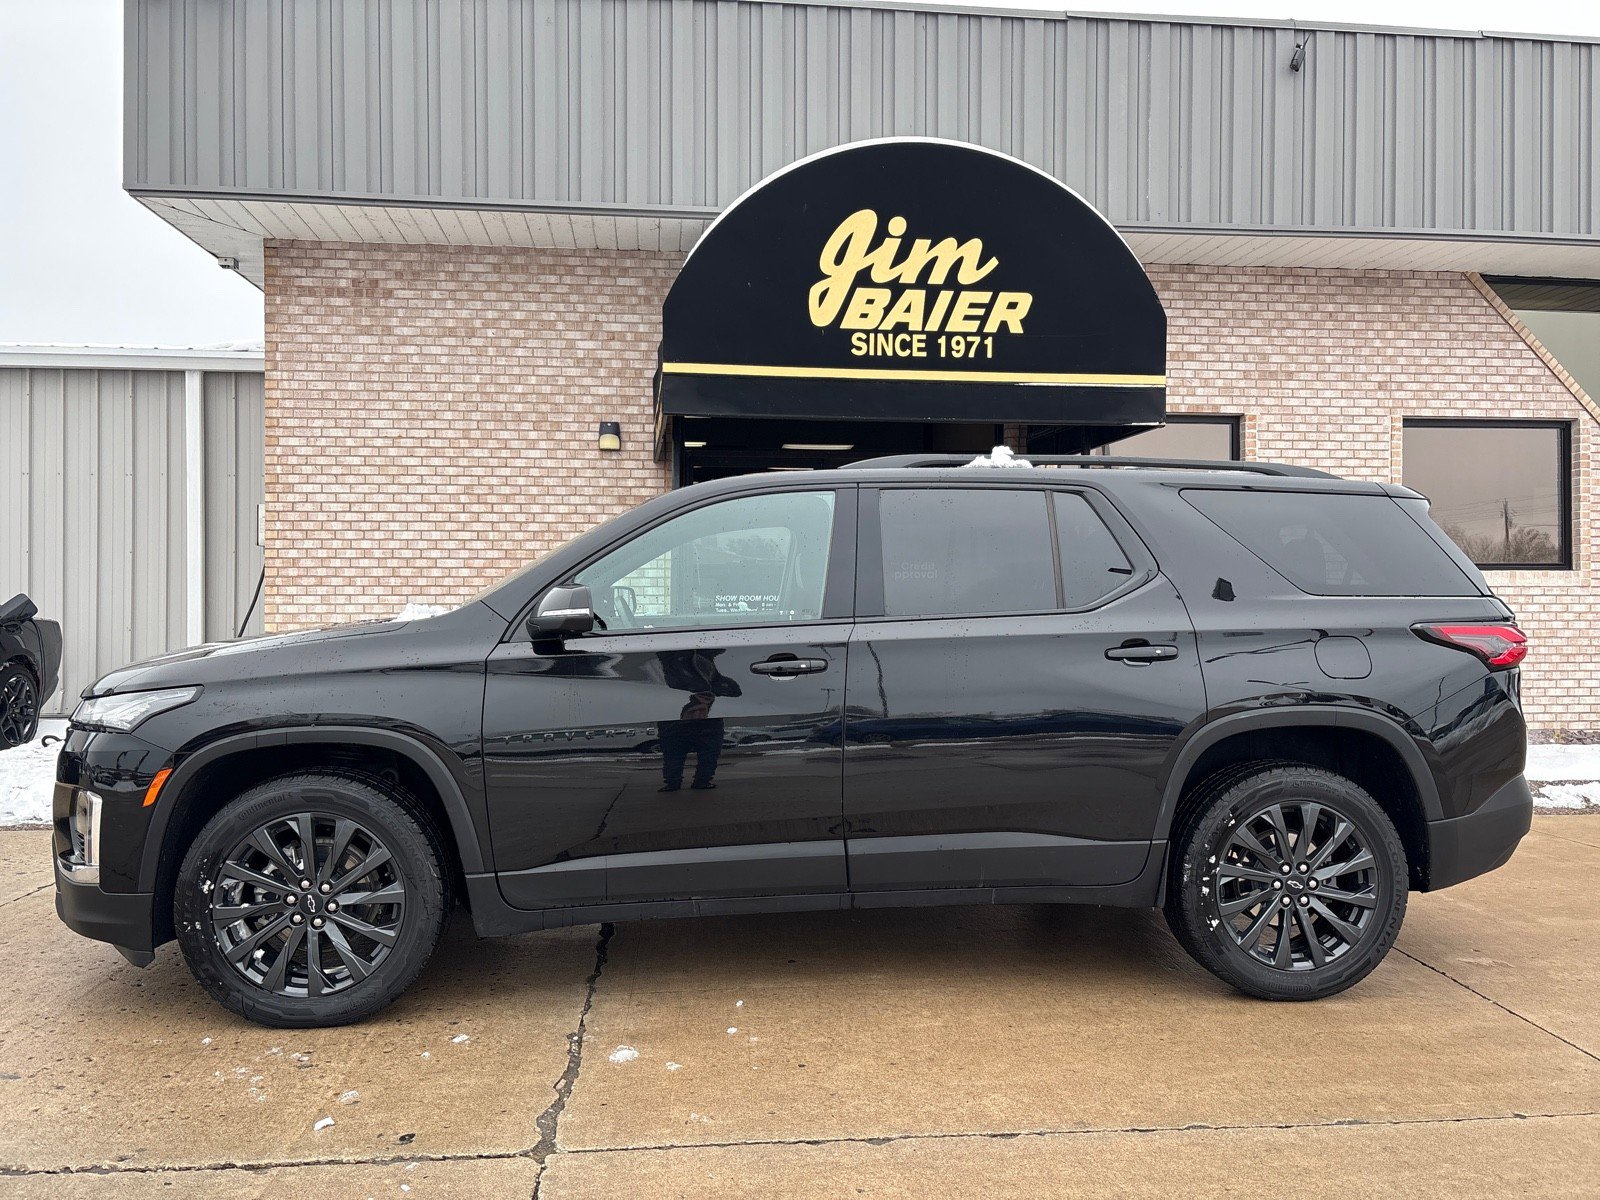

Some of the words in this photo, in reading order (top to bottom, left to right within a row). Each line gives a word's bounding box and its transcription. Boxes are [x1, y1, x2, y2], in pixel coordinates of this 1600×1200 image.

[808, 208, 999, 327] Jim
[839, 287, 1033, 334] BAIER
[850, 332, 927, 357] SINCE
[937, 336, 993, 359] 1971
[505, 727, 656, 745] TRAVERSE
